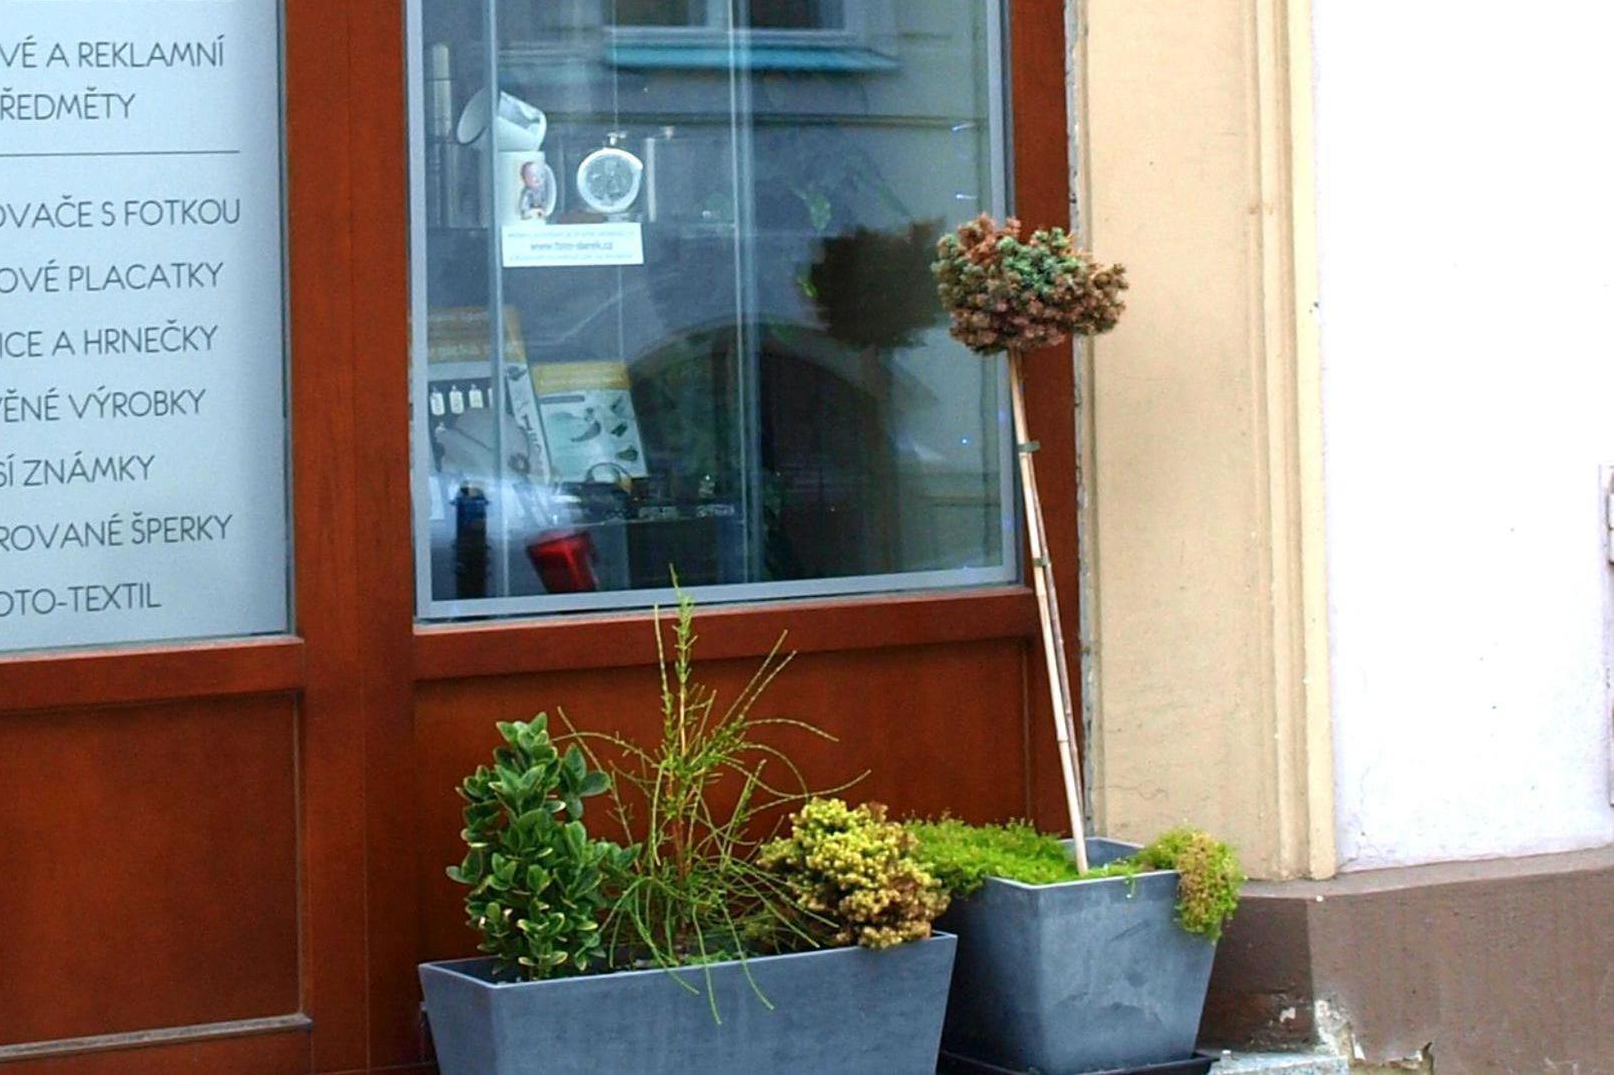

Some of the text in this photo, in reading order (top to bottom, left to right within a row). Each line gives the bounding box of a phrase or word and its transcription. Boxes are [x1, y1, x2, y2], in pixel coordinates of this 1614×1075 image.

[47, 43, 68, 67] A
[79, 35, 224, 67] REKLAMNÍ
[101, 200, 115, 227] S
[125, 198, 241, 227] FOTKOU
[69, 262, 223, 292] PLACATKY
[51, 329, 75, 356] A
[84, 321, 218, 355] HRNEČKY
[68, 388, 206, 418] VÝROBKY
[24, 451, 155, 486] ZNÁMKY
[131, 511, 232, 545] ŠPERKY
